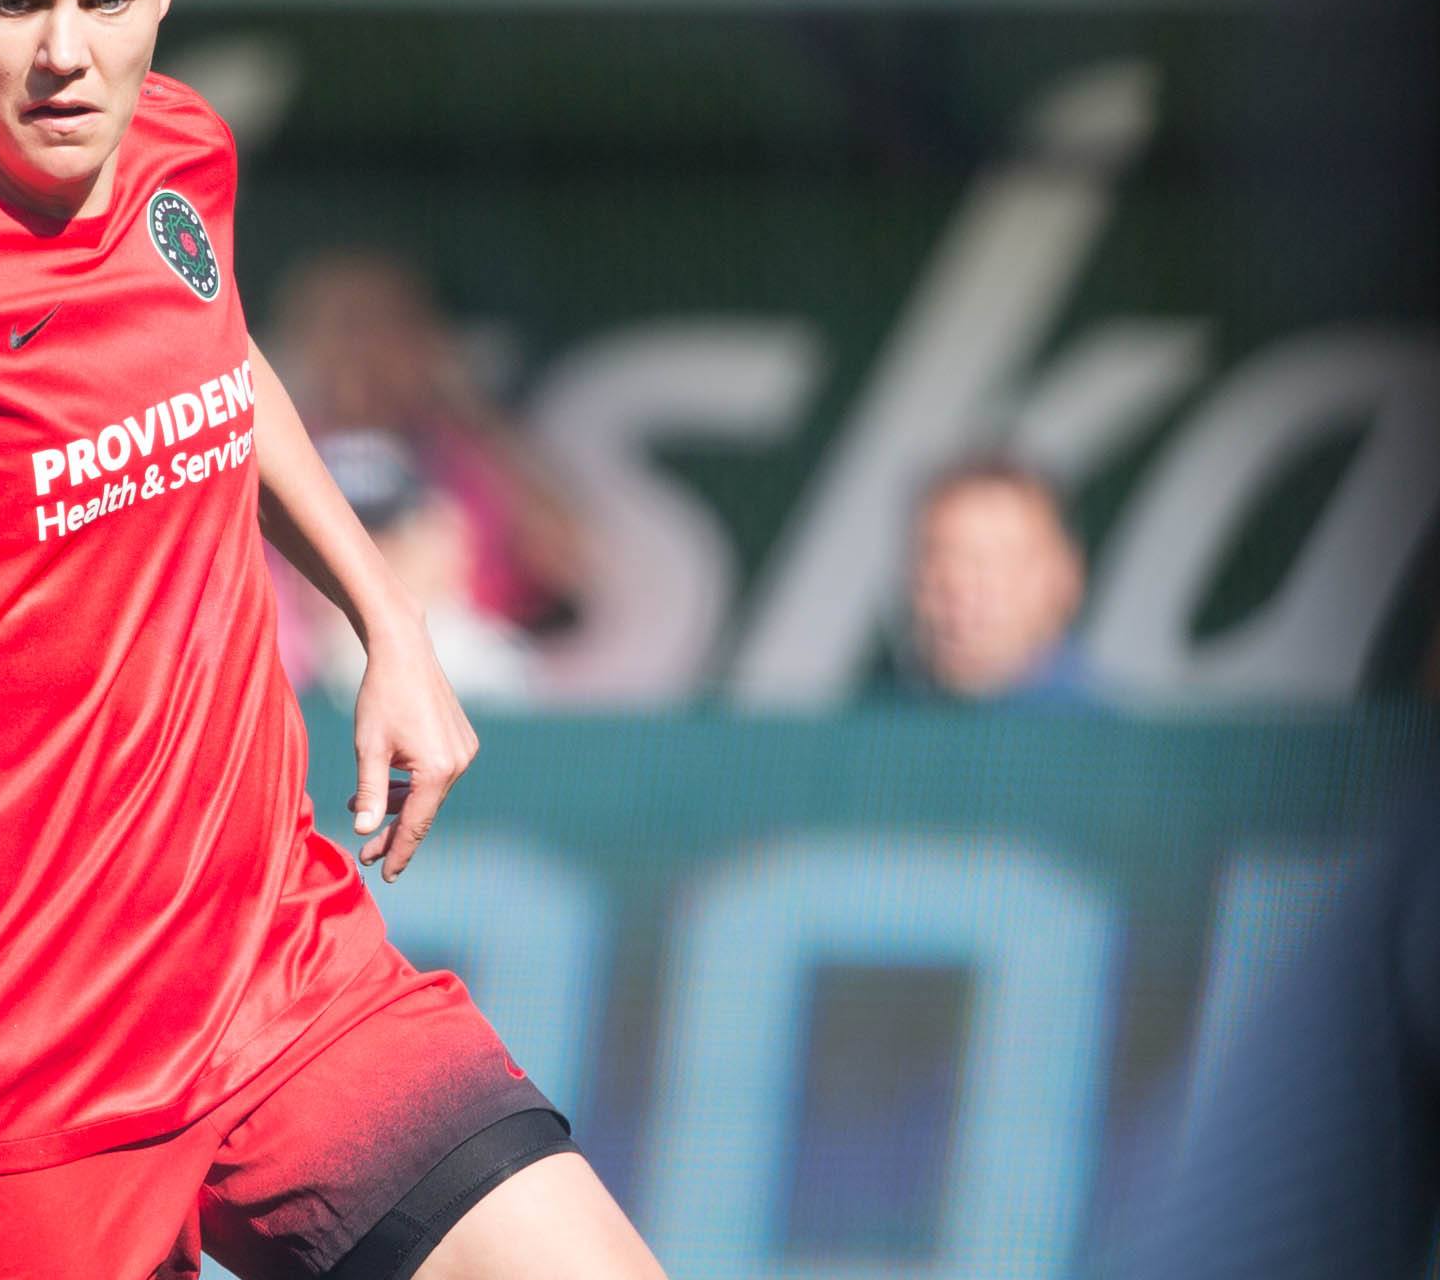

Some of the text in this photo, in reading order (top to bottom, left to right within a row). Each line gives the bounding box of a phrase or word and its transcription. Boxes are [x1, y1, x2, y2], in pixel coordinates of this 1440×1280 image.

[153, 199, 199, 245] PORTLAND
[180, 248, 217, 292] THORNS
[35, 426, 254, 542] Health & Services
